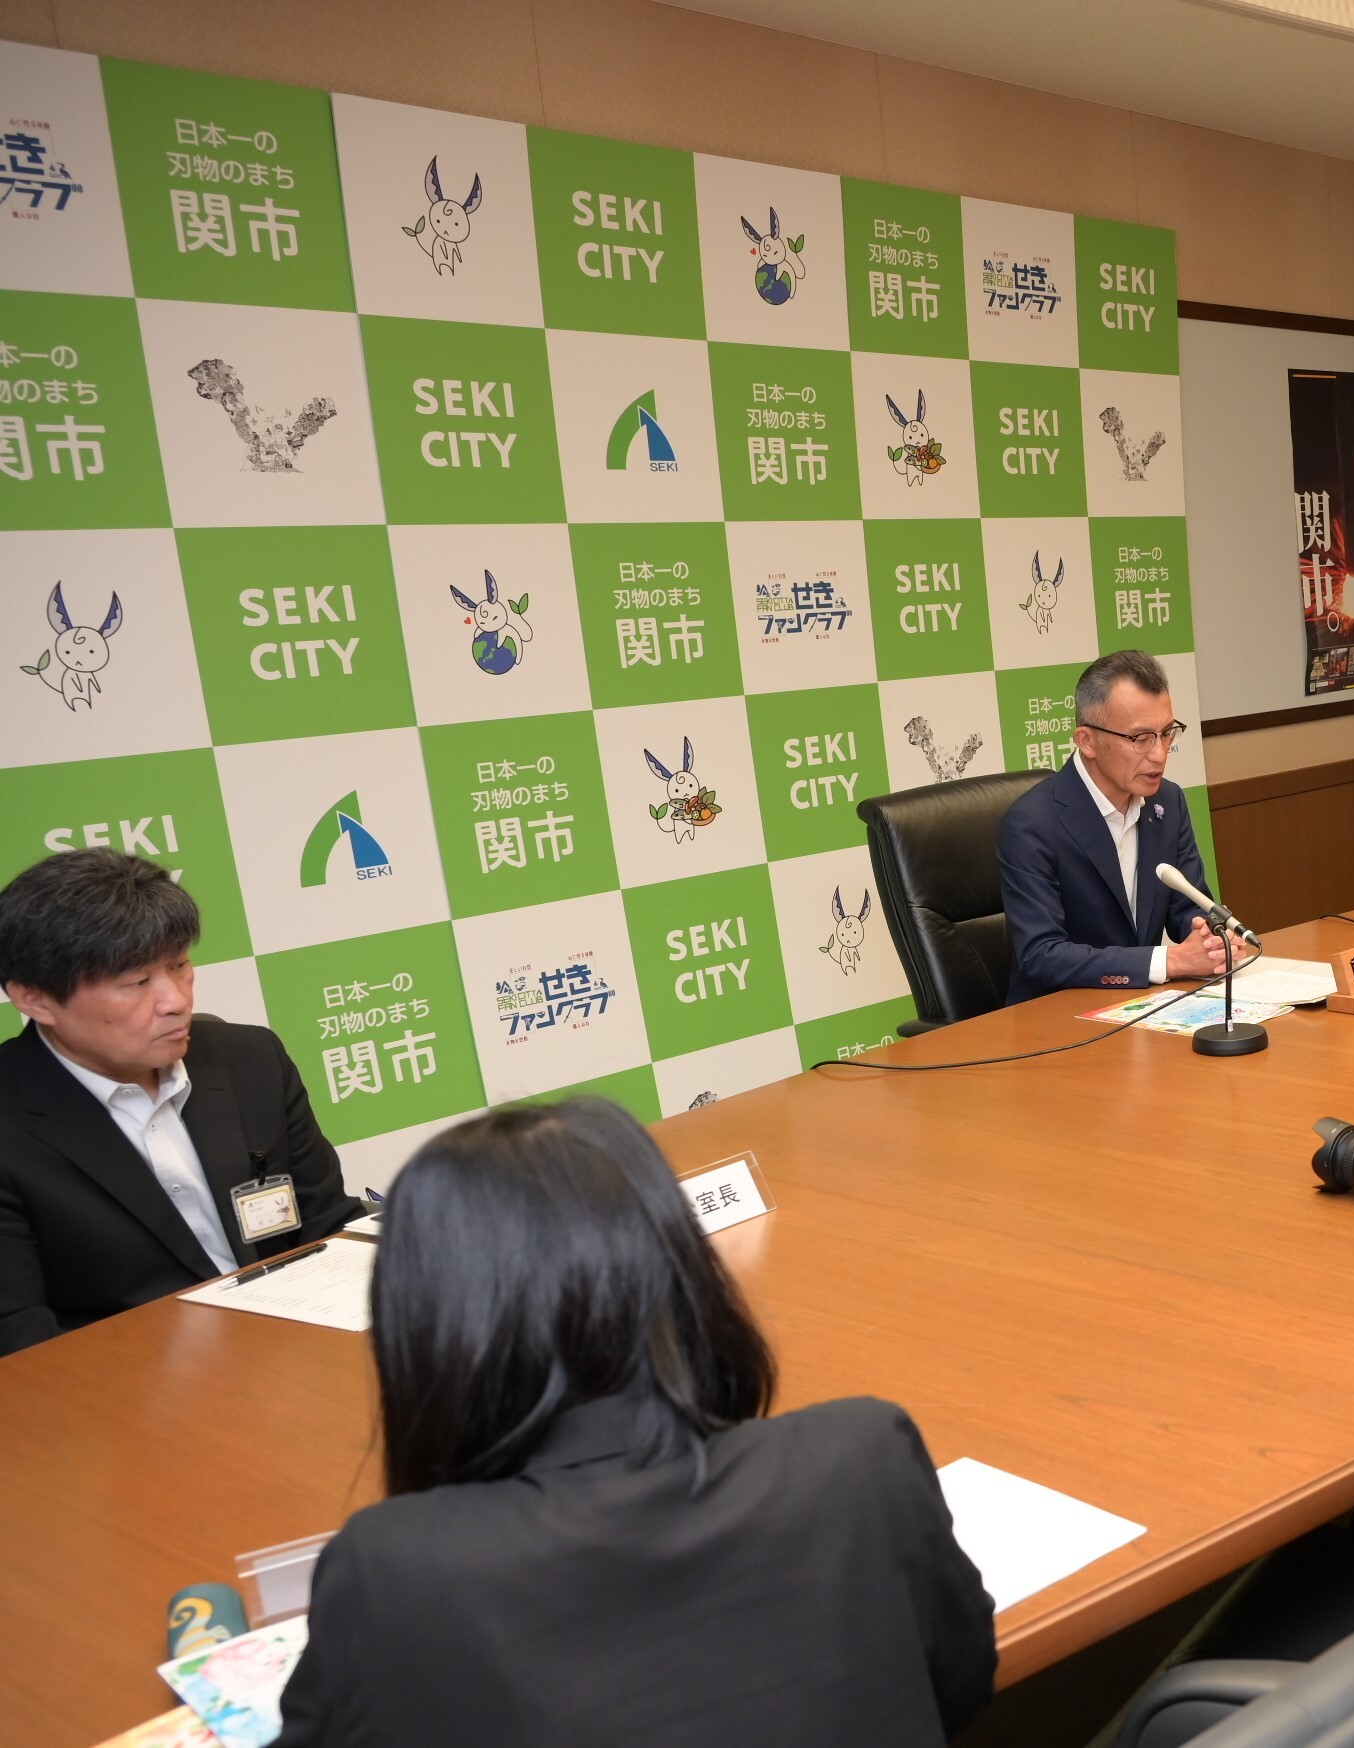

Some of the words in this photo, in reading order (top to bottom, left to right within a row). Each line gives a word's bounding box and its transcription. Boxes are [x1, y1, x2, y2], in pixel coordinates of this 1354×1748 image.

[174, 118, 278, 155] 日本一の
[166, 151, 295, 190] 刃物のまち
[169, 188, 300, 262] 関市
[572, 190, 663, 236] SEKI
[873, 219, 930, 244] 日本一の
[577, 242, 664, 283] CITY
[868, 243, 939, 270] 刃物のまち
[1100, 262, 1155, 295] SEKI
[869, 271, 940, 323] 関市
[1101, 301, 1155, 332] CITY
[413, 378, 514, 419] SEKI
[753, 383, 816, 404] 日本一の
[746, 409, 826, 430] 刃物のまち
[1000, 407, 1058, 437] SEKI
[420, 431, 516, 468] CITY
[650, 462, 678, 472] SEKI
[747, 437, 828, 486] 関市
[1002, 447, 1059, 475] CITY
[619, 561, 689, 582] 日本一の
[1119, 546, 1162, 563] 日本一の
[895, 562, 960, 593] SEKI
[1115, 567, 1170, 584] 刃物のまち
[239, 584, 357, 627] SEKI
[613, 587, 700, 610] 刃物のまち
[1115, 588, 1171, 629] 関市
[900, 603, 962, 634] CITY
[250, 637, 360, 680] CITY
[615, 614, 705, 668] 関市
[1028, 695, 1076, 714] 日本一の
[1024, 716, 1076, 736] 刃物のま
[785, 732, 857, 768] SEKI
[477, 756, 555, 784] 日本一の
[471, 781, 569, 812] 刃物のまち
[790, 773, 859, 810] CITY
[474, 811, 574, 873] 関市
[357, 866, 392, 881] SEKI
[666, 917, 748, 962] SEKI
[323, 973, 413, 1009] 日本一の
[674, 959, 750, 1004] CITY
[317, 998, 430, 1040] 刃物のまち
[321, 1030, 437, 1104] 関市
[690, 1183, 741, 1218] 室長
